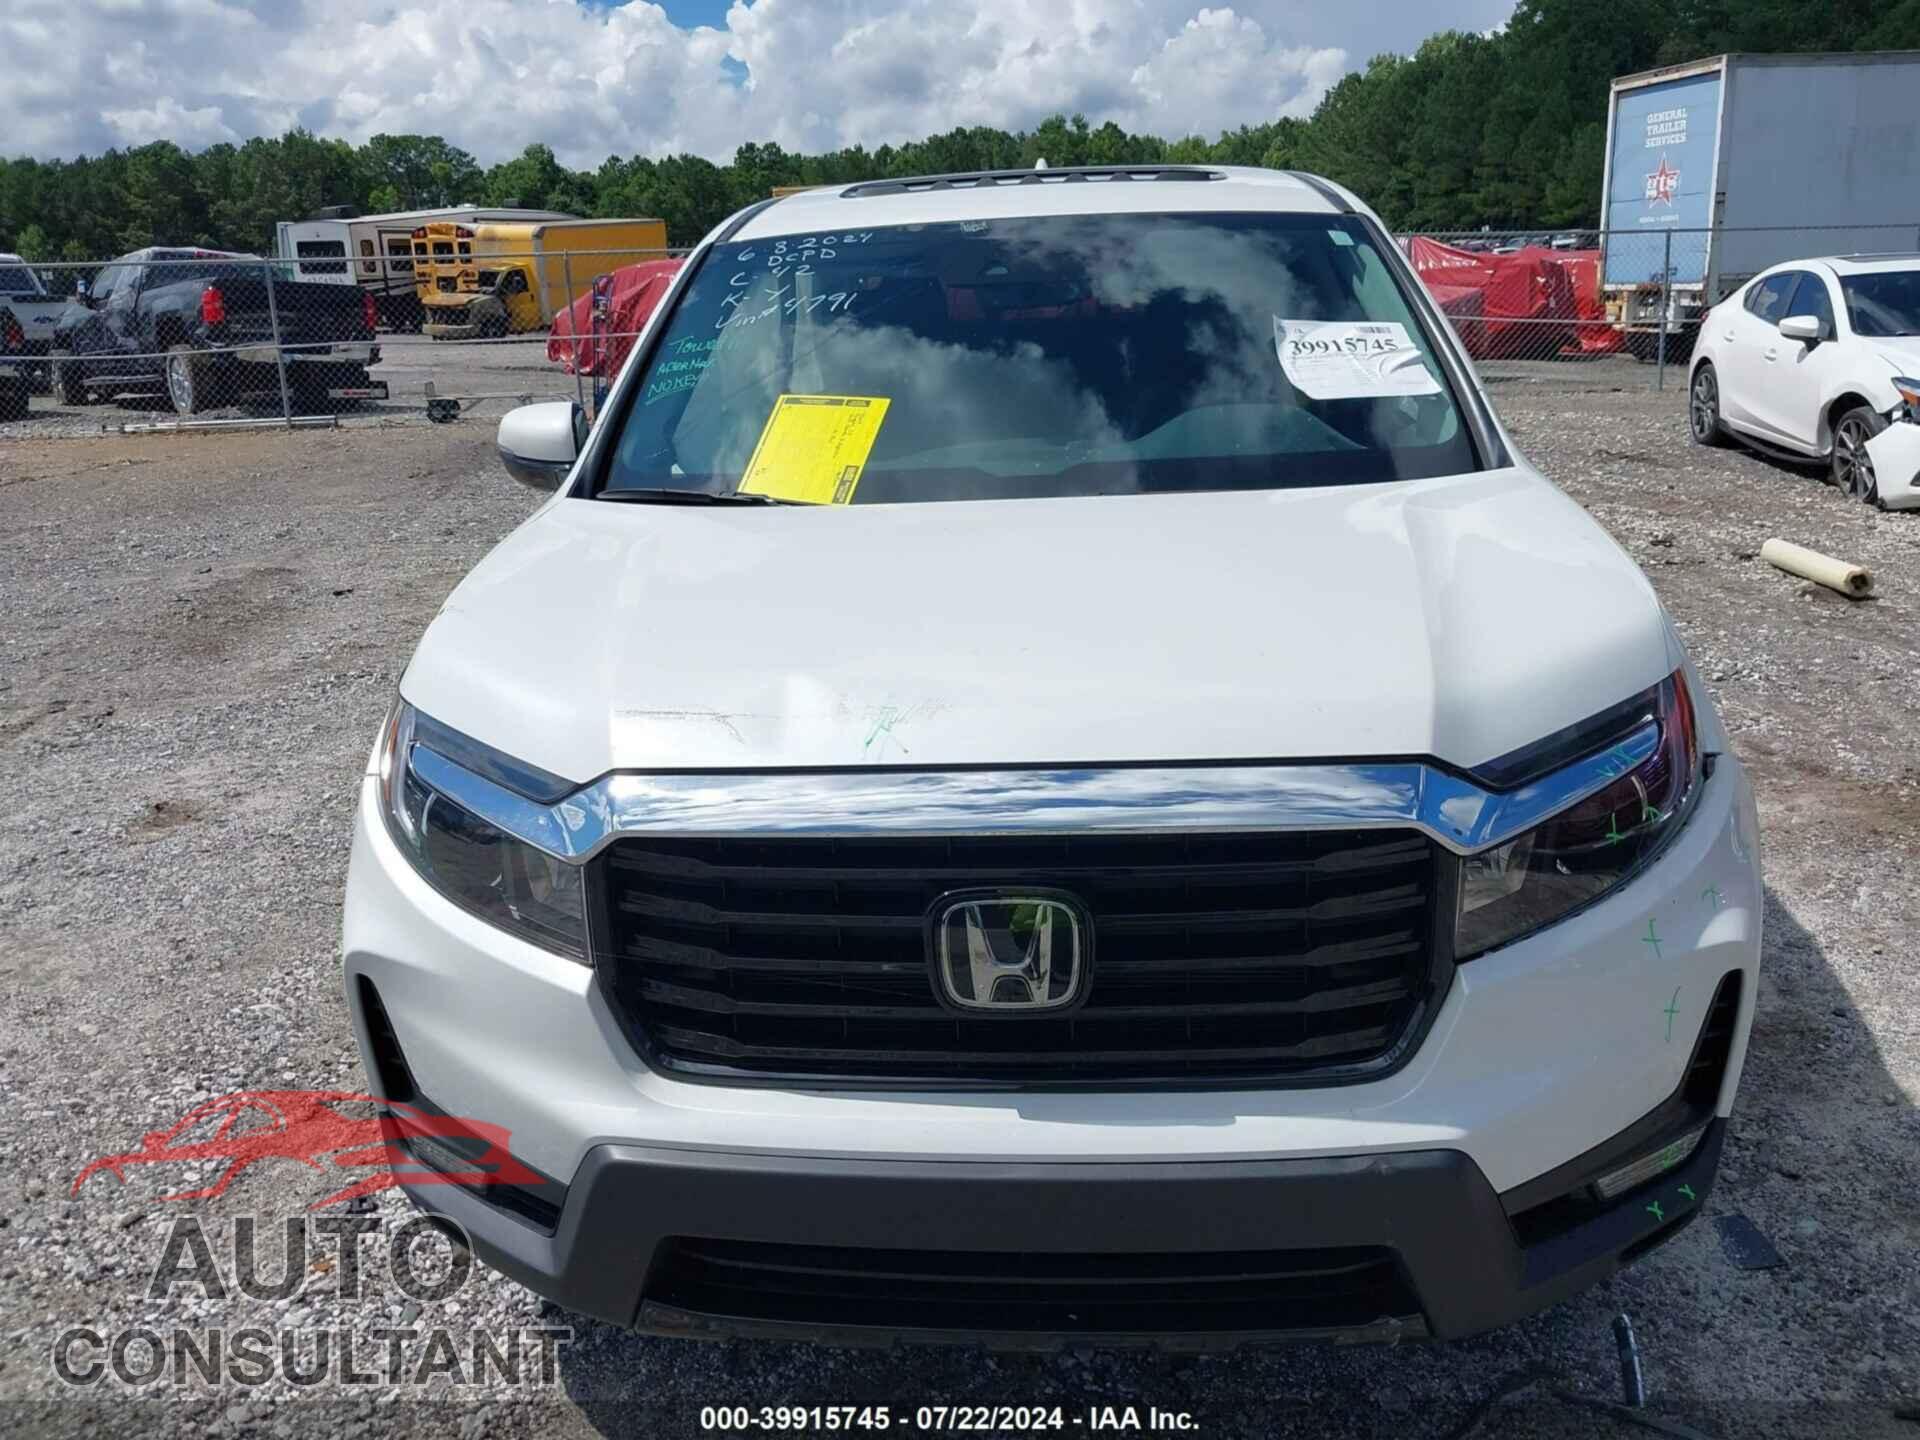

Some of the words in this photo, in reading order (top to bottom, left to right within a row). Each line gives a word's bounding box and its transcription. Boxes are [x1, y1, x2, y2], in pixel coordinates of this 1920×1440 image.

[1647, 108, 1687, 124] GENERAL
[1647, 120, 1686, 135] TRAILER
[1645, 132, 1686, 148] SERVICES
[1288, 337, 1399, 357] 39915745
